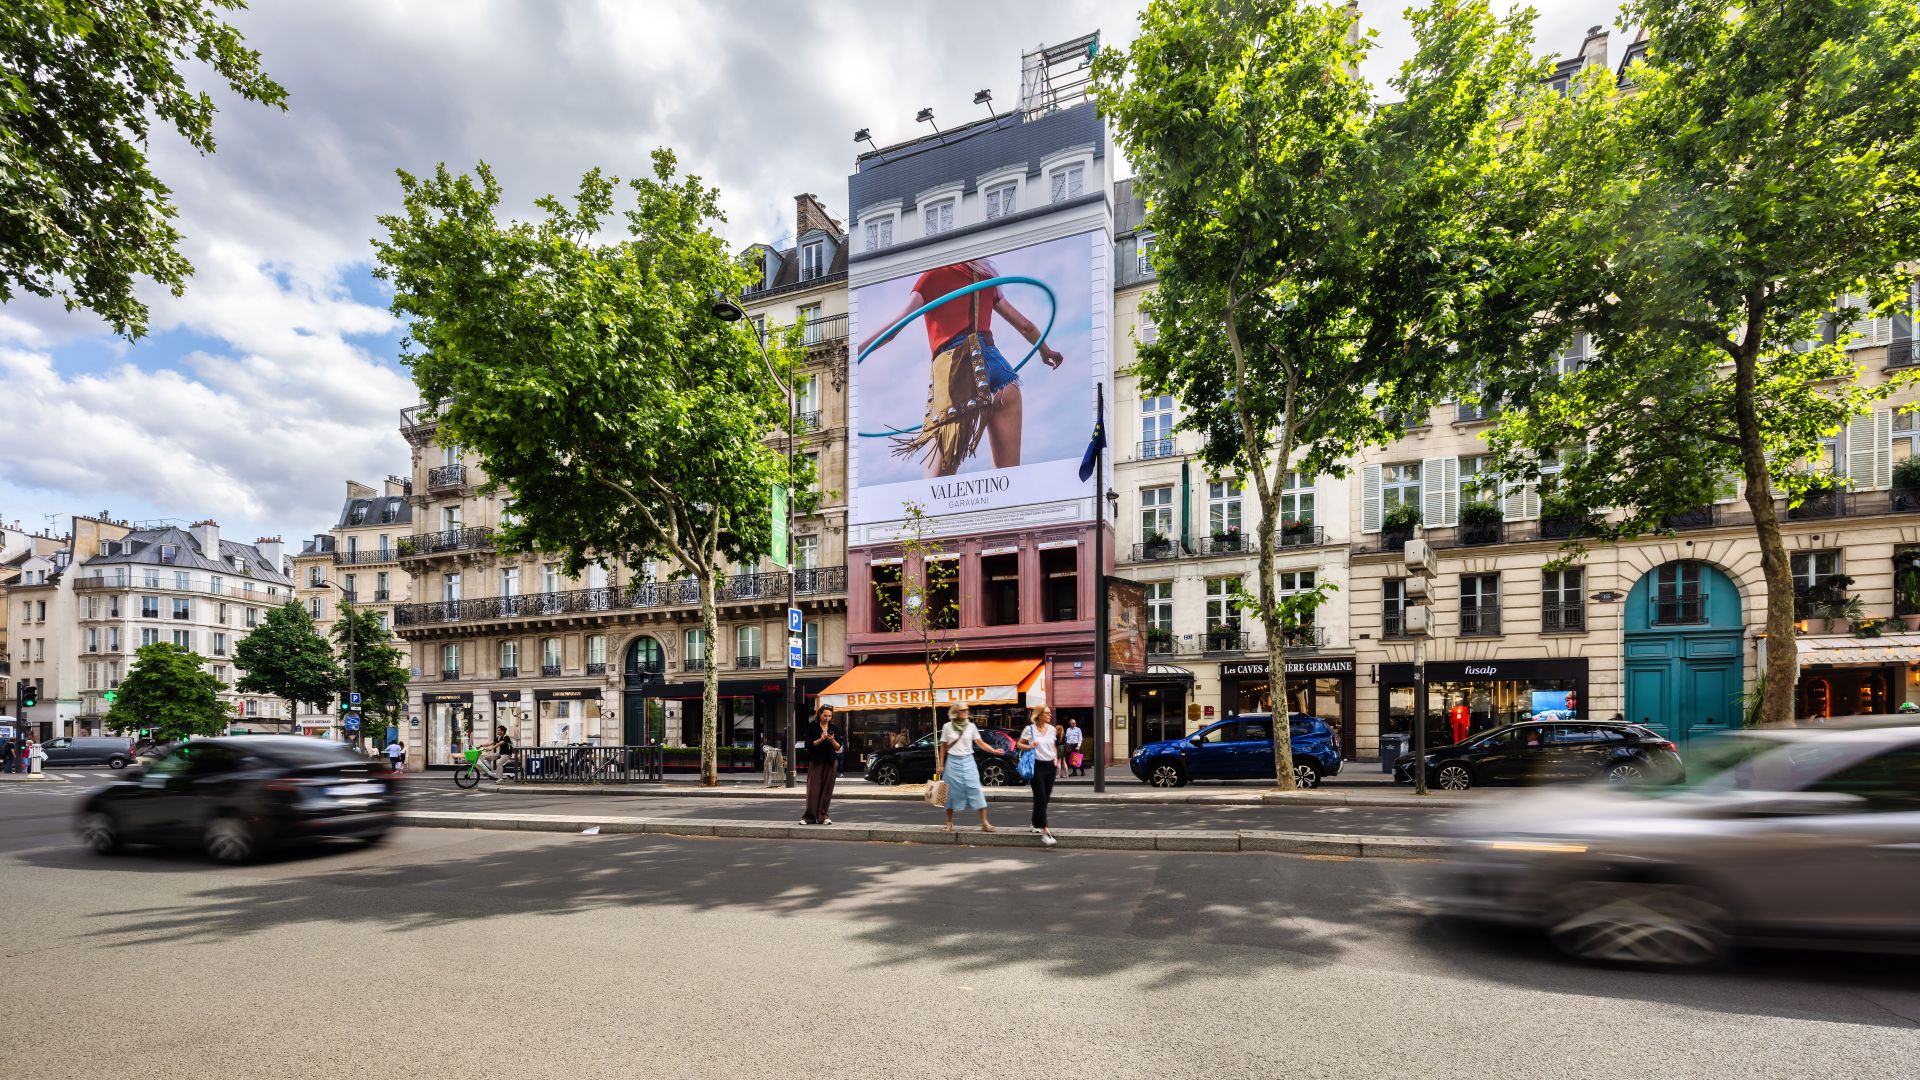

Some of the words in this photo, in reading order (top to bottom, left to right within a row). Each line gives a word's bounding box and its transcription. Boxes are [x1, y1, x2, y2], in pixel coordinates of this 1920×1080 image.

[931, 476, 1009, 499] VALENTINO
[948, 496, 989, 508] GARAVANI
[792, 613, 799, 627] P
[1224, 665, 1236, 674] Les
[1238, 664, 1263, 674] CAVES
[1306, 661, 1352, 672] GERMAINE
[1465, 665, 1497, 676] fusalp
[847, 690, 936, 706] BRASSERIE
[949, 688, 986, 702] LIPP
[532, 760, 541, 773] P
